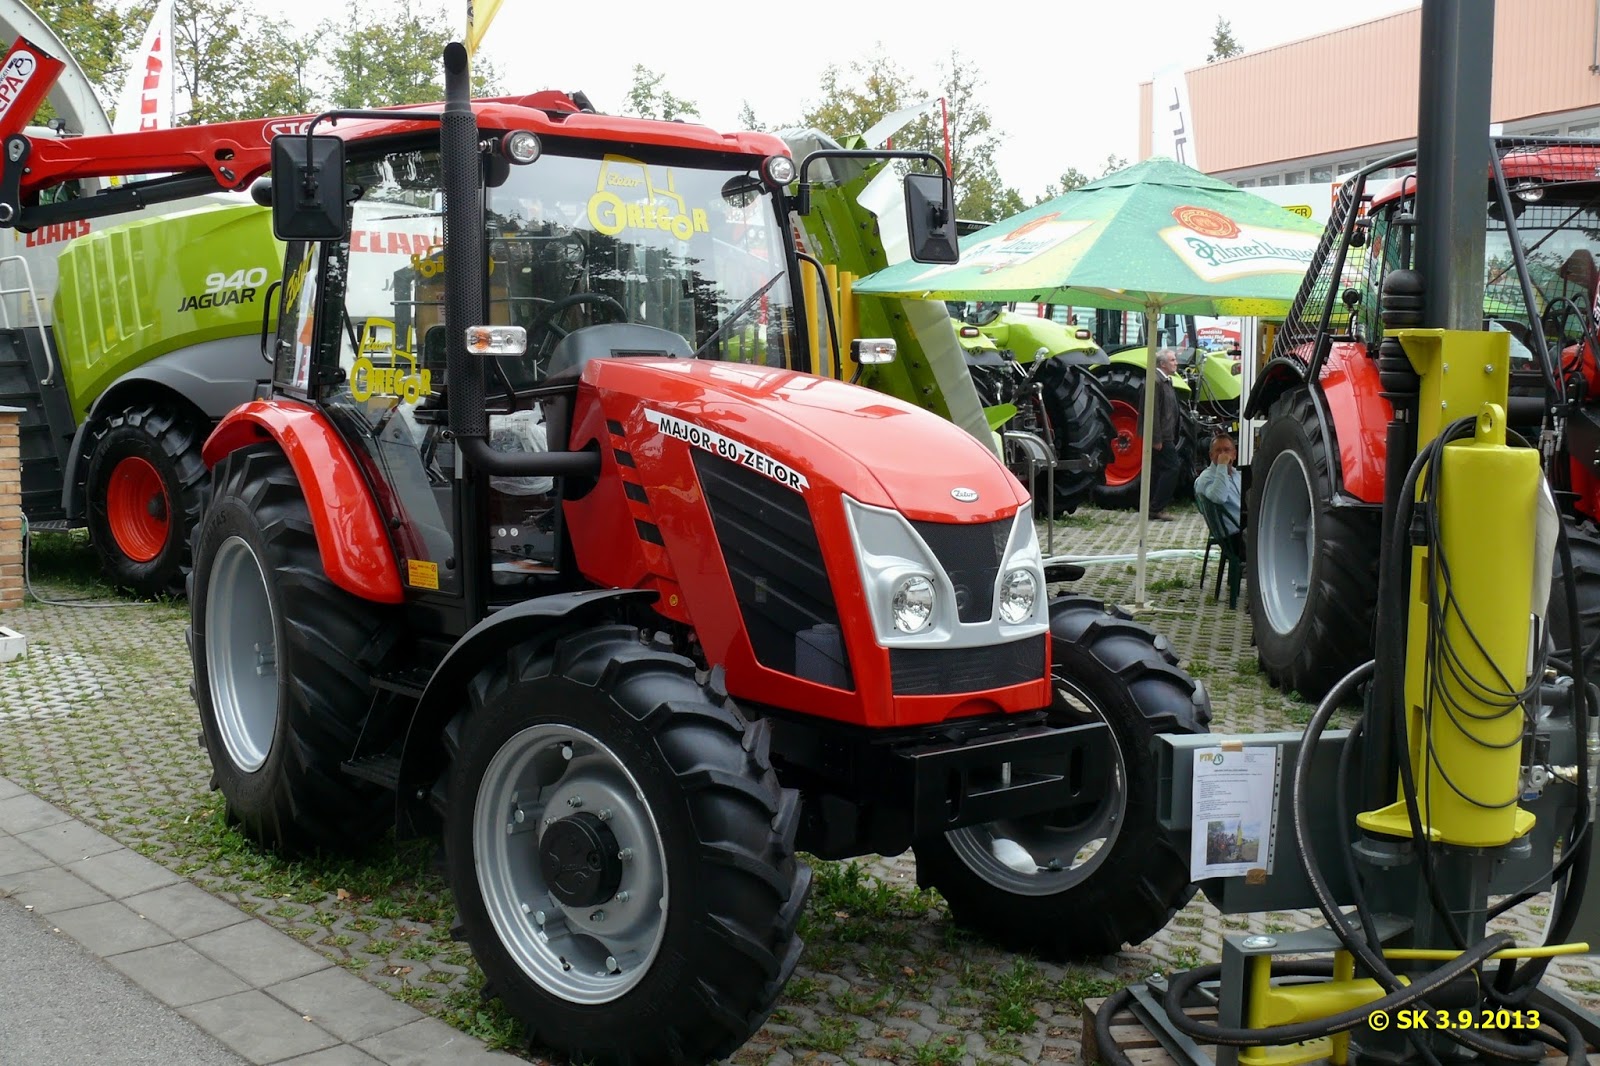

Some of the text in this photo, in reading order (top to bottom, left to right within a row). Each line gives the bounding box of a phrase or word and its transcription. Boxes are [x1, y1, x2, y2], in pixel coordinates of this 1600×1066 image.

[1184, 237, 1260, 266] Pilsner
[205, 267, 268, 294] 940
[177, 288, 257, 312] JAGUAR
[660, 417, 801, 490] MAJOR 80 ZETOR
